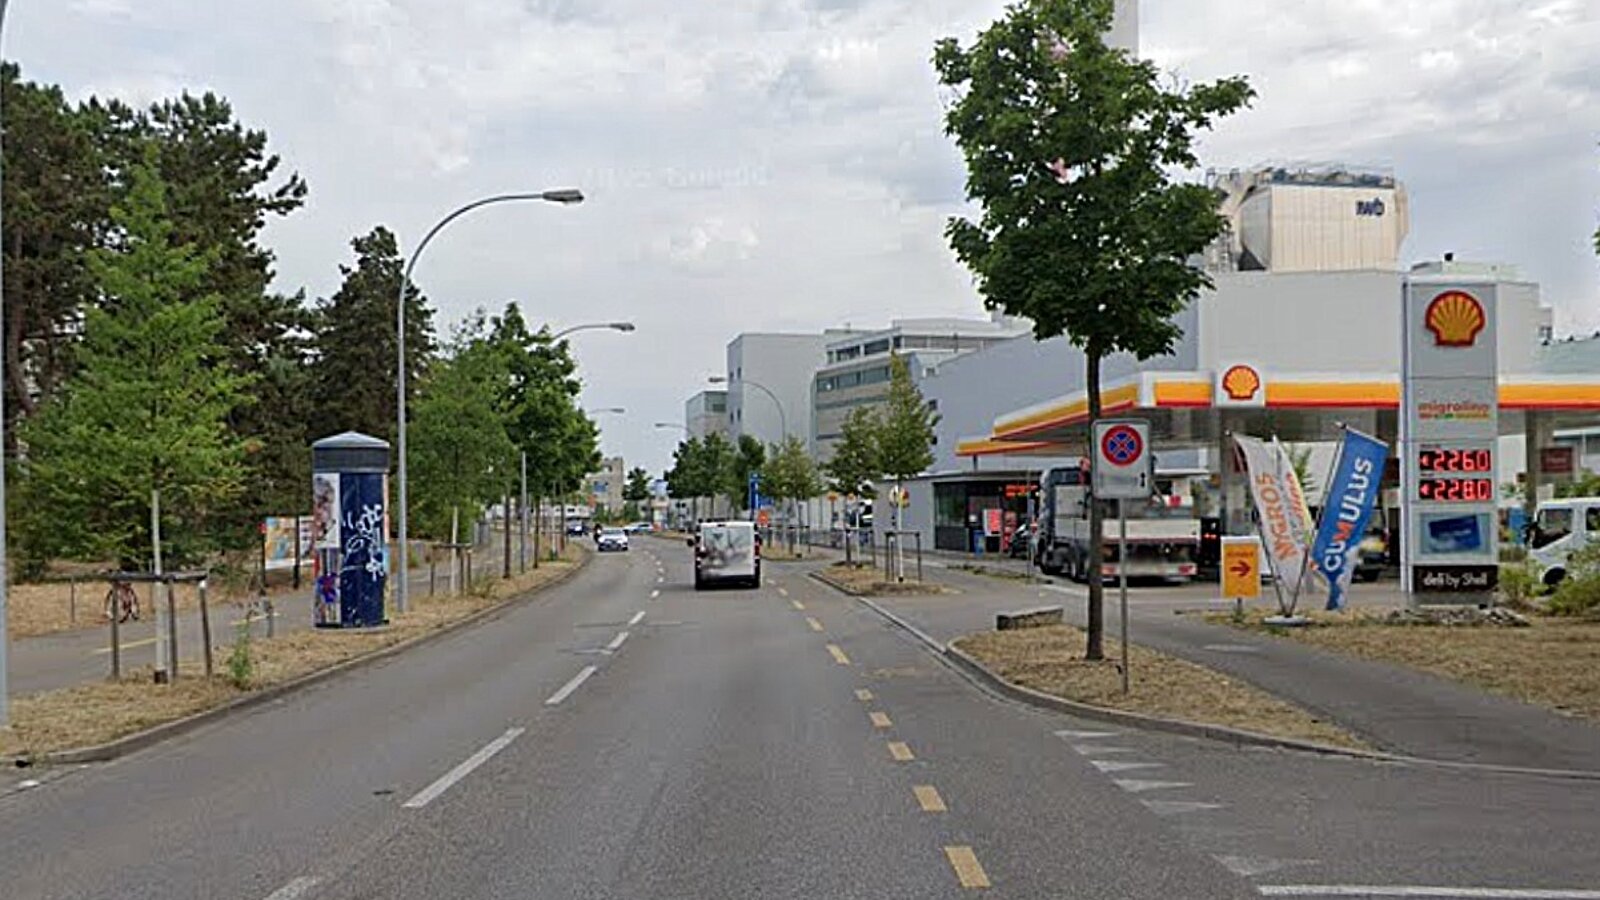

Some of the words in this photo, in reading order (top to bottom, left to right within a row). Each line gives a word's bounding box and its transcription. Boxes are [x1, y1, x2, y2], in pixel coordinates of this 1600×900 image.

[1324, 458, 1372, 571] CUMULUS
[1446, 573, 1460, 589] by
[1462, 572, 1487, 586] Shell
